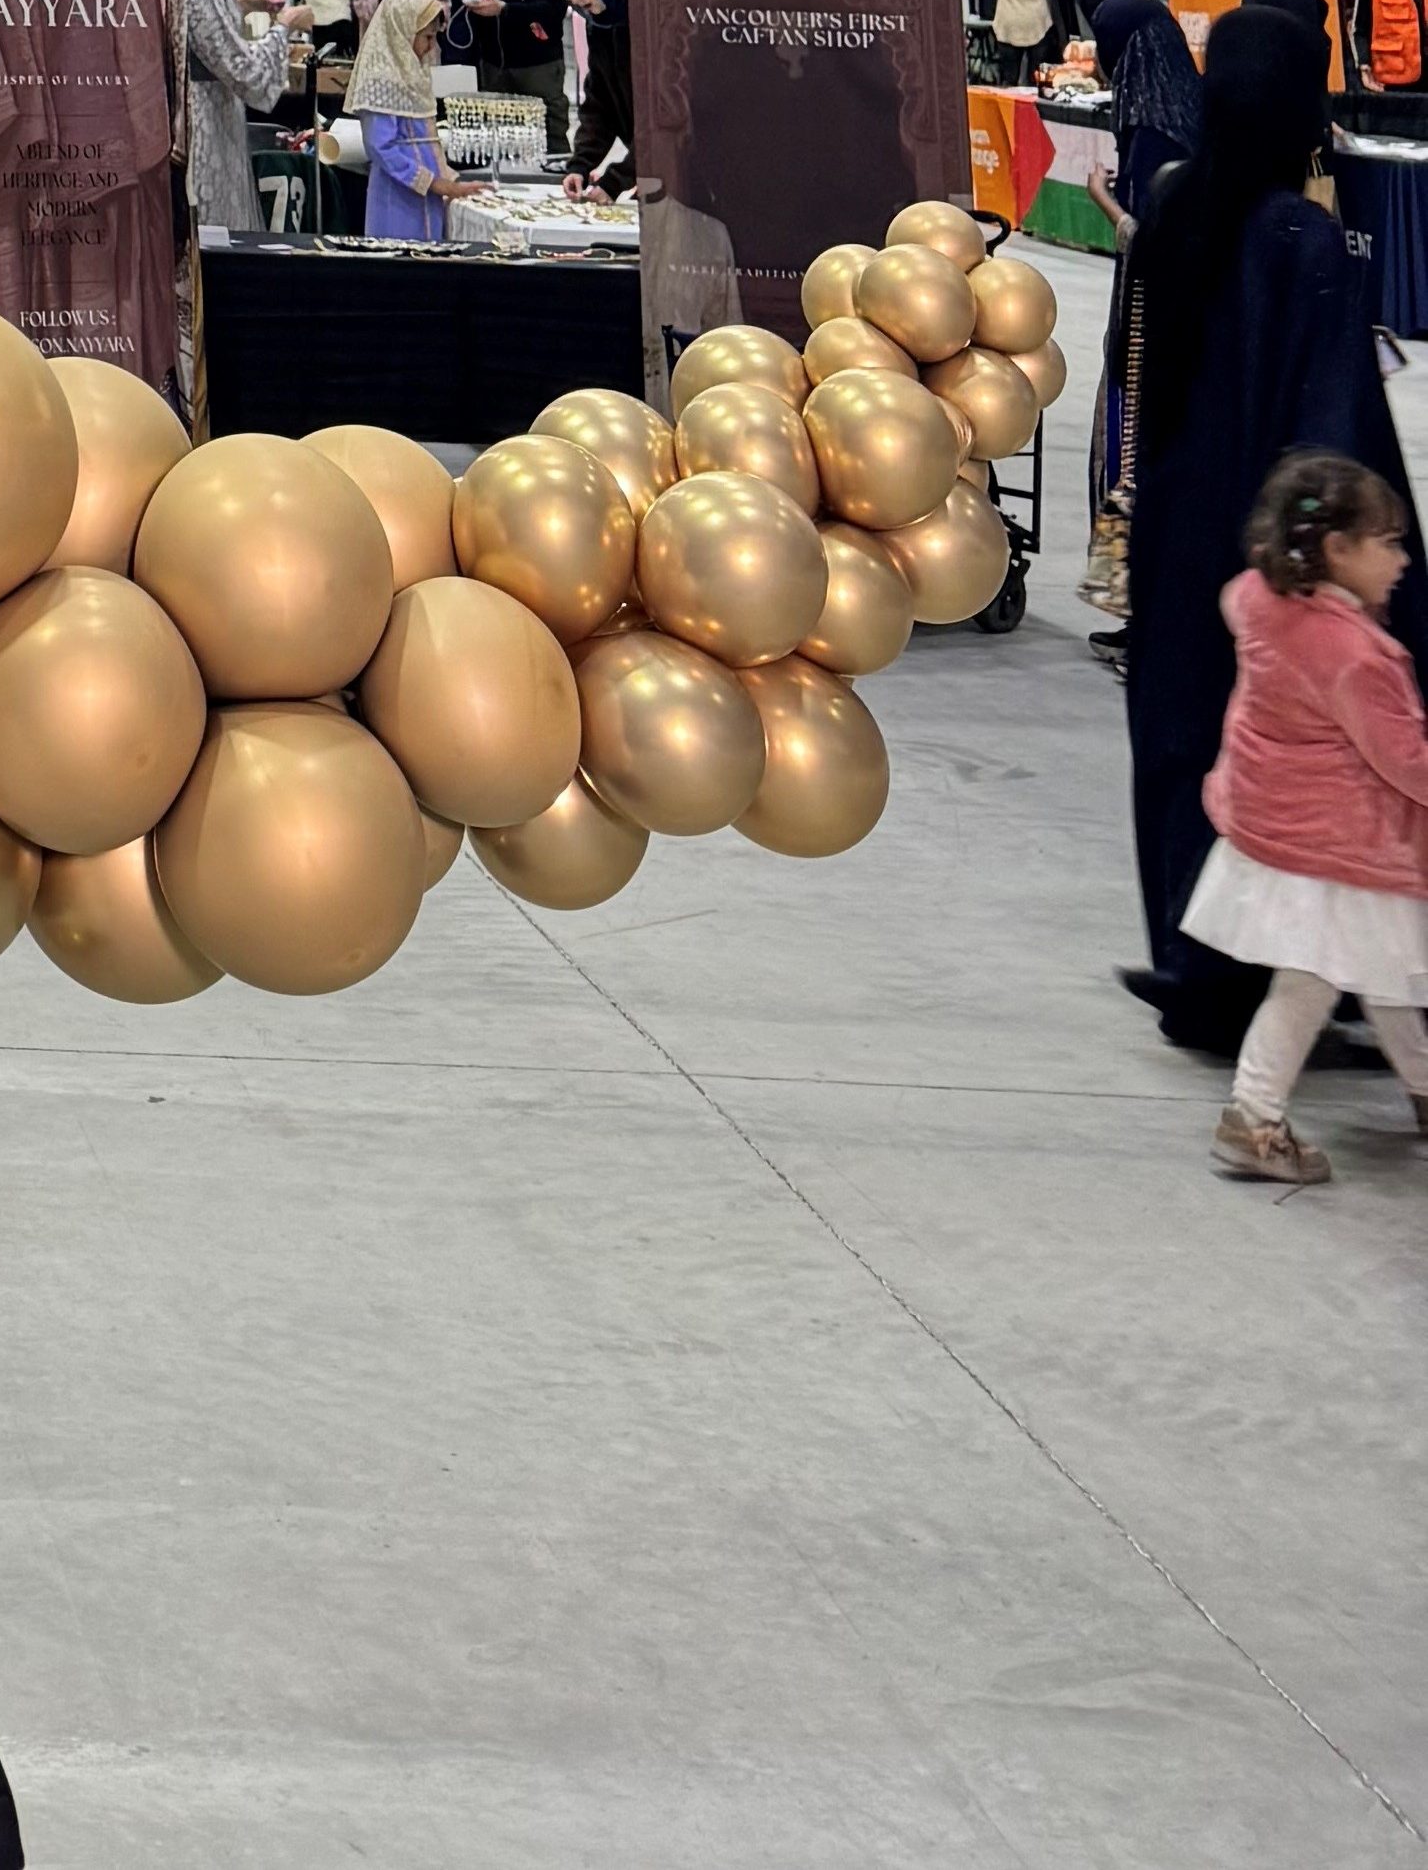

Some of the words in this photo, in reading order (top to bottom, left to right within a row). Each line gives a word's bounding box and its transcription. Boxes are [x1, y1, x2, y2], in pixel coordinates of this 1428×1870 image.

[686, 7, 842, 29] VANCOUVER'S
[848, 13, 908, 32] FIRST
[722, 26, 808, 46] CAFTAN
[814, 31, 874, 49] SHOP
[52, 75, 68, 85] OF
[77, 75, 130, 86] LUXURY
[26, 143, 79, 160] BLEND
[83, 144, 105, 160] OF
[2, 172, 82, 189] HERITAGE
[87, 172, 119, 188] AND
[27, 201, 97, 217] MODERN
[21, 229, 106, 246] ELEGANCE
[1346, 230, 1373, 260] ENT
[20, 310, 85, 327] FOLLOW
[33, 336, 135, 353] SON.NAYYARA
